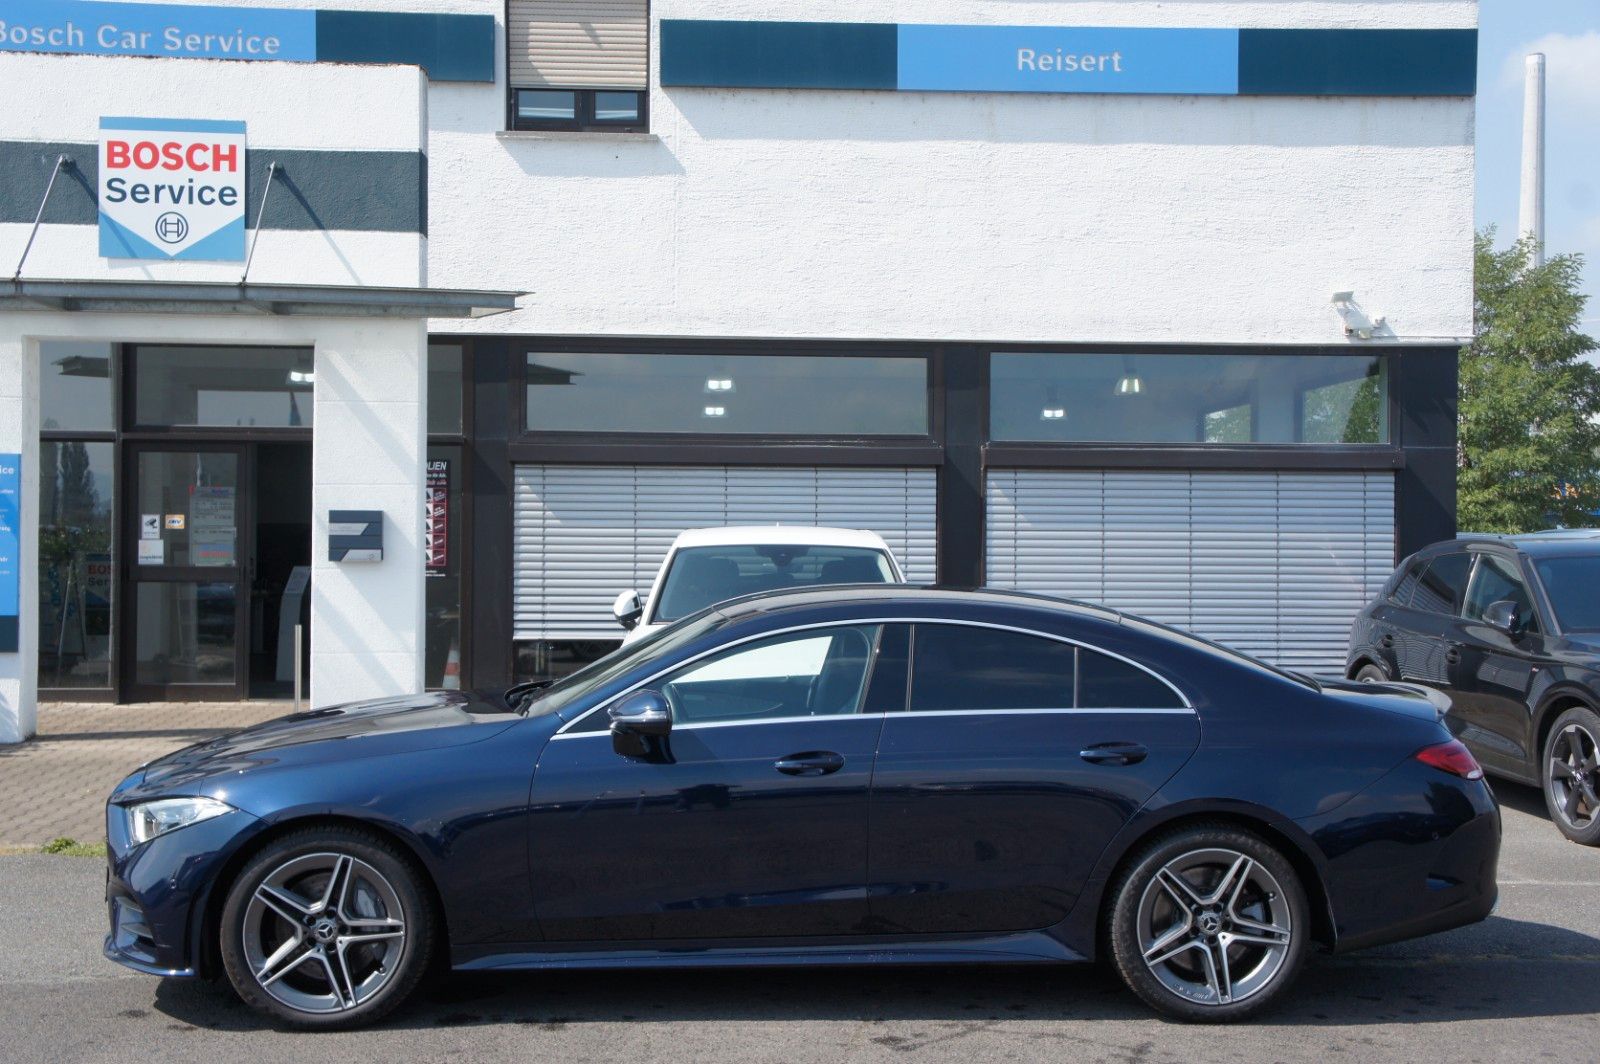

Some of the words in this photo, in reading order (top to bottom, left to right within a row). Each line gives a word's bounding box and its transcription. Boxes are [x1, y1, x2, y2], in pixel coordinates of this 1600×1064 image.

[97, 24, 151, 48] Car
[164, 26, 280, 54] Service
[1017, 48, 1122, 71] Reisert
[107, 140, 237, 172] BOSCH
[105, 177, 238, 206] Service
[426, 461, 447, 470] LIEN
